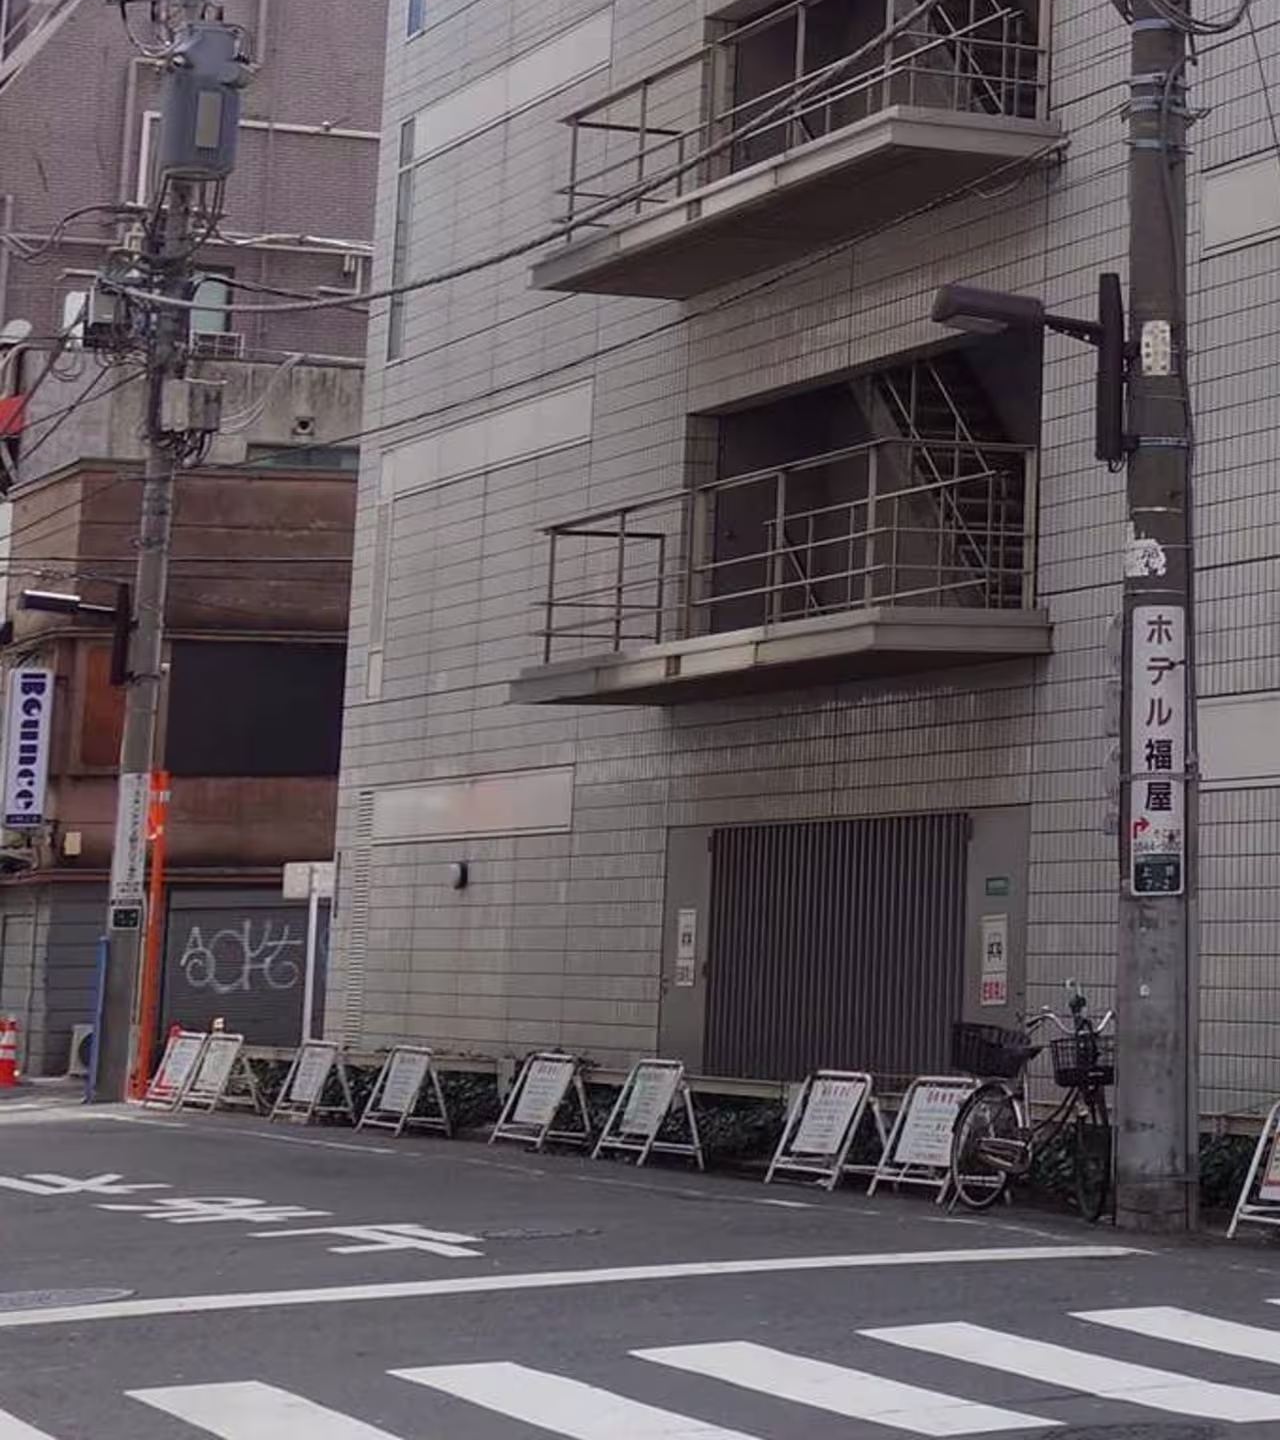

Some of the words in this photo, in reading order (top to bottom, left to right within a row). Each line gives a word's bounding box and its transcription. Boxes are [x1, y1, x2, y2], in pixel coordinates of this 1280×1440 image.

[1145, 614, 1173, 811] ホテル福屋
